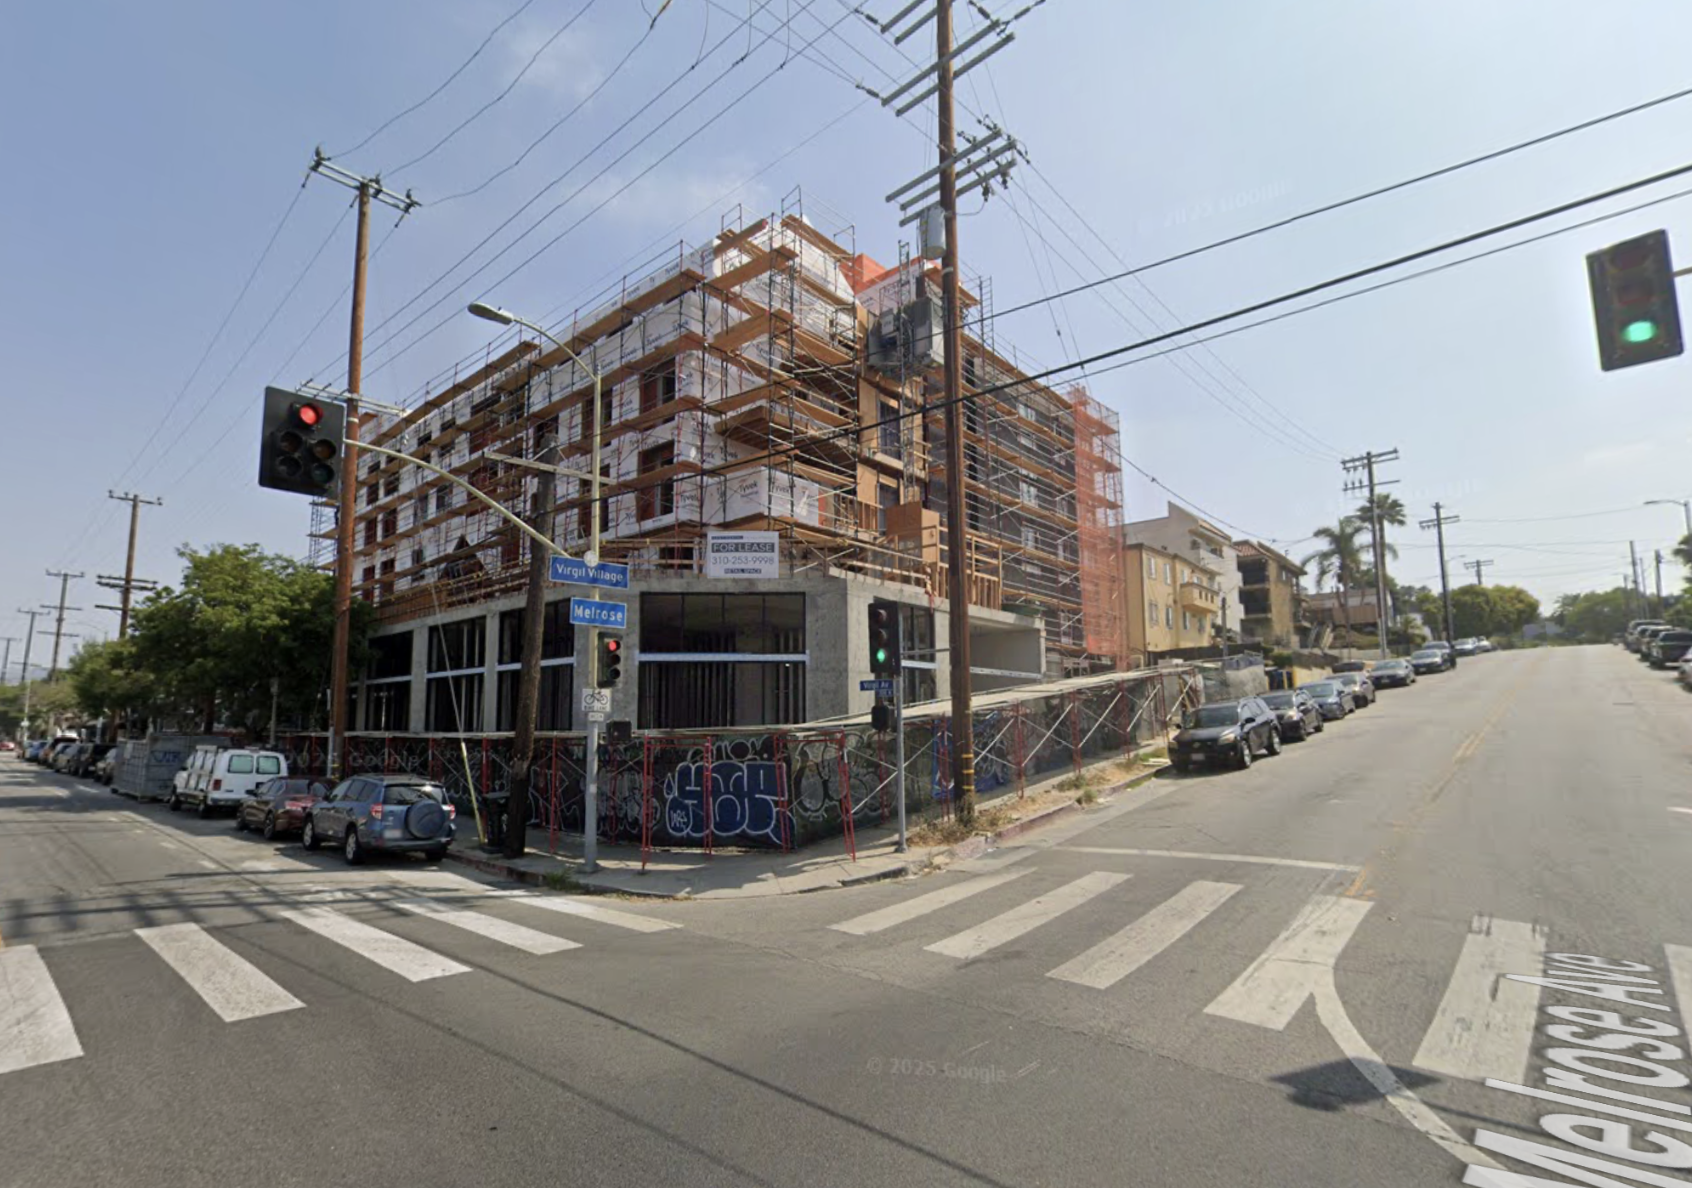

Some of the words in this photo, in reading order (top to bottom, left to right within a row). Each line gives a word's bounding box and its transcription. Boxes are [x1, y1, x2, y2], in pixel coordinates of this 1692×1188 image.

[739, 481, 758, 493] Tyvek
[714, 543, 735, 552] FOR
[739, 543, 773, 552] LEASE
[711, 556, 775, 565] 310-253-9998
[556, 563, 586, 579] Virgil
[587, 567, 624, 583] Village
[574, 604, 623, 622] Melrose
